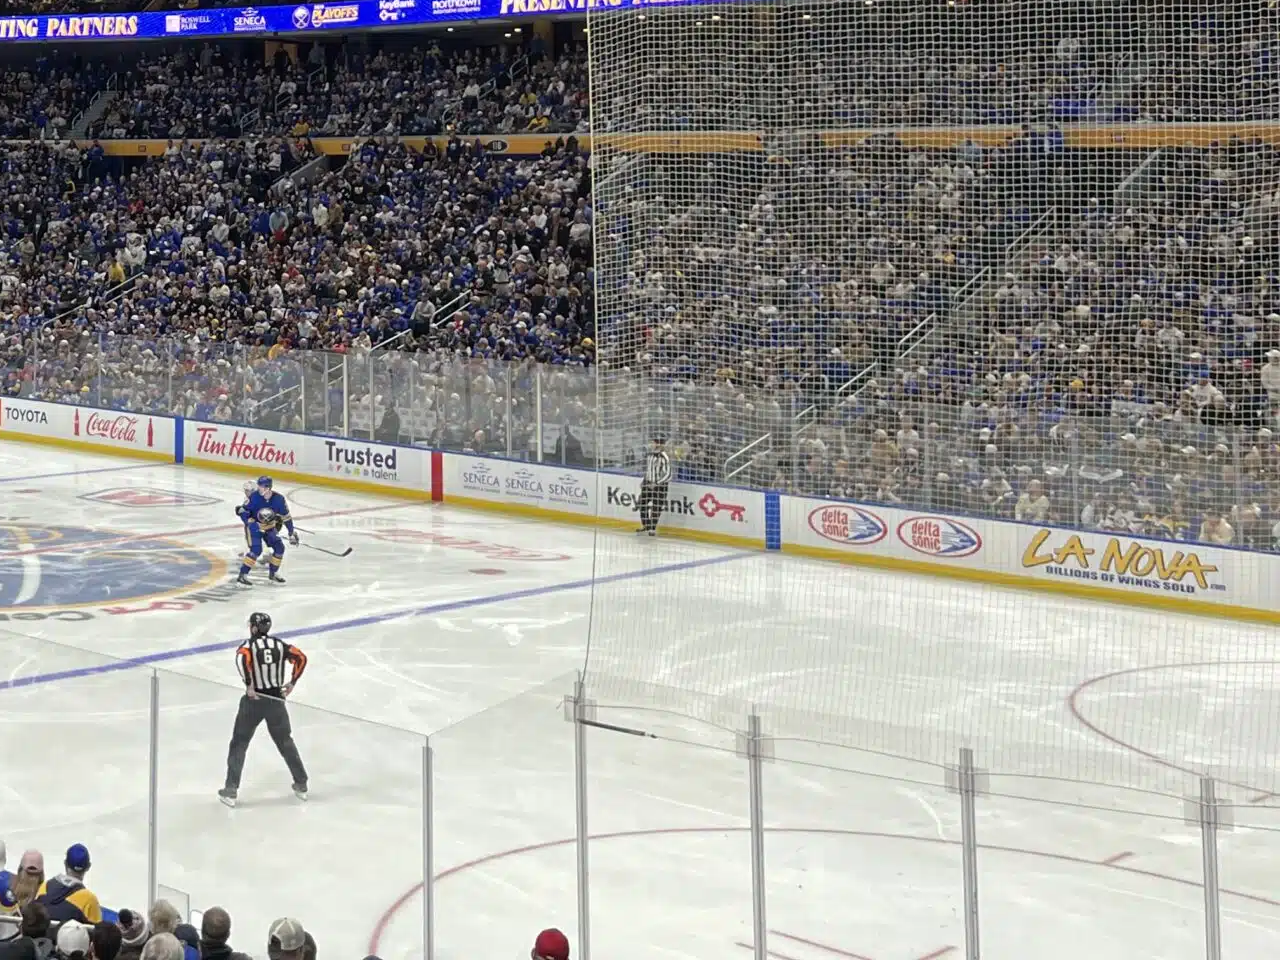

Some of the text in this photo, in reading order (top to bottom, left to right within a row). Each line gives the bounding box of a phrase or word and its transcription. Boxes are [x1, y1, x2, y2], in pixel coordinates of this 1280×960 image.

[233, 16, 267, 27] SENECA
[311, 4, 359, 22] PLAYOFFS
[46, 15, 138, 38] PARTNERS
[5, 407, 48, 425] TOYOTA
[196, 427, 297, 467] Tim Hortons
[325, 440, 397, 470] Trusted
[371, 468, 398, 481] talent
[462, 471, 500, 487] SENECA
[505, 477, 544, 493] SENECA
[548, 483, 589, 500] SENECA
[607, 486, 695, 515] Keynk
[821, 510, 849, 527] delta
[821, 524, 850, 539] sonic
[911, 522, 940, 540] delta
[912, 536, 942, 552] sonic
[1022, 528, 1218, 589] LA NOVA
[1045, 564, 1196, 594] BILLIONS OF WINGS SOLD
[263, 648, 273, 664] 6
